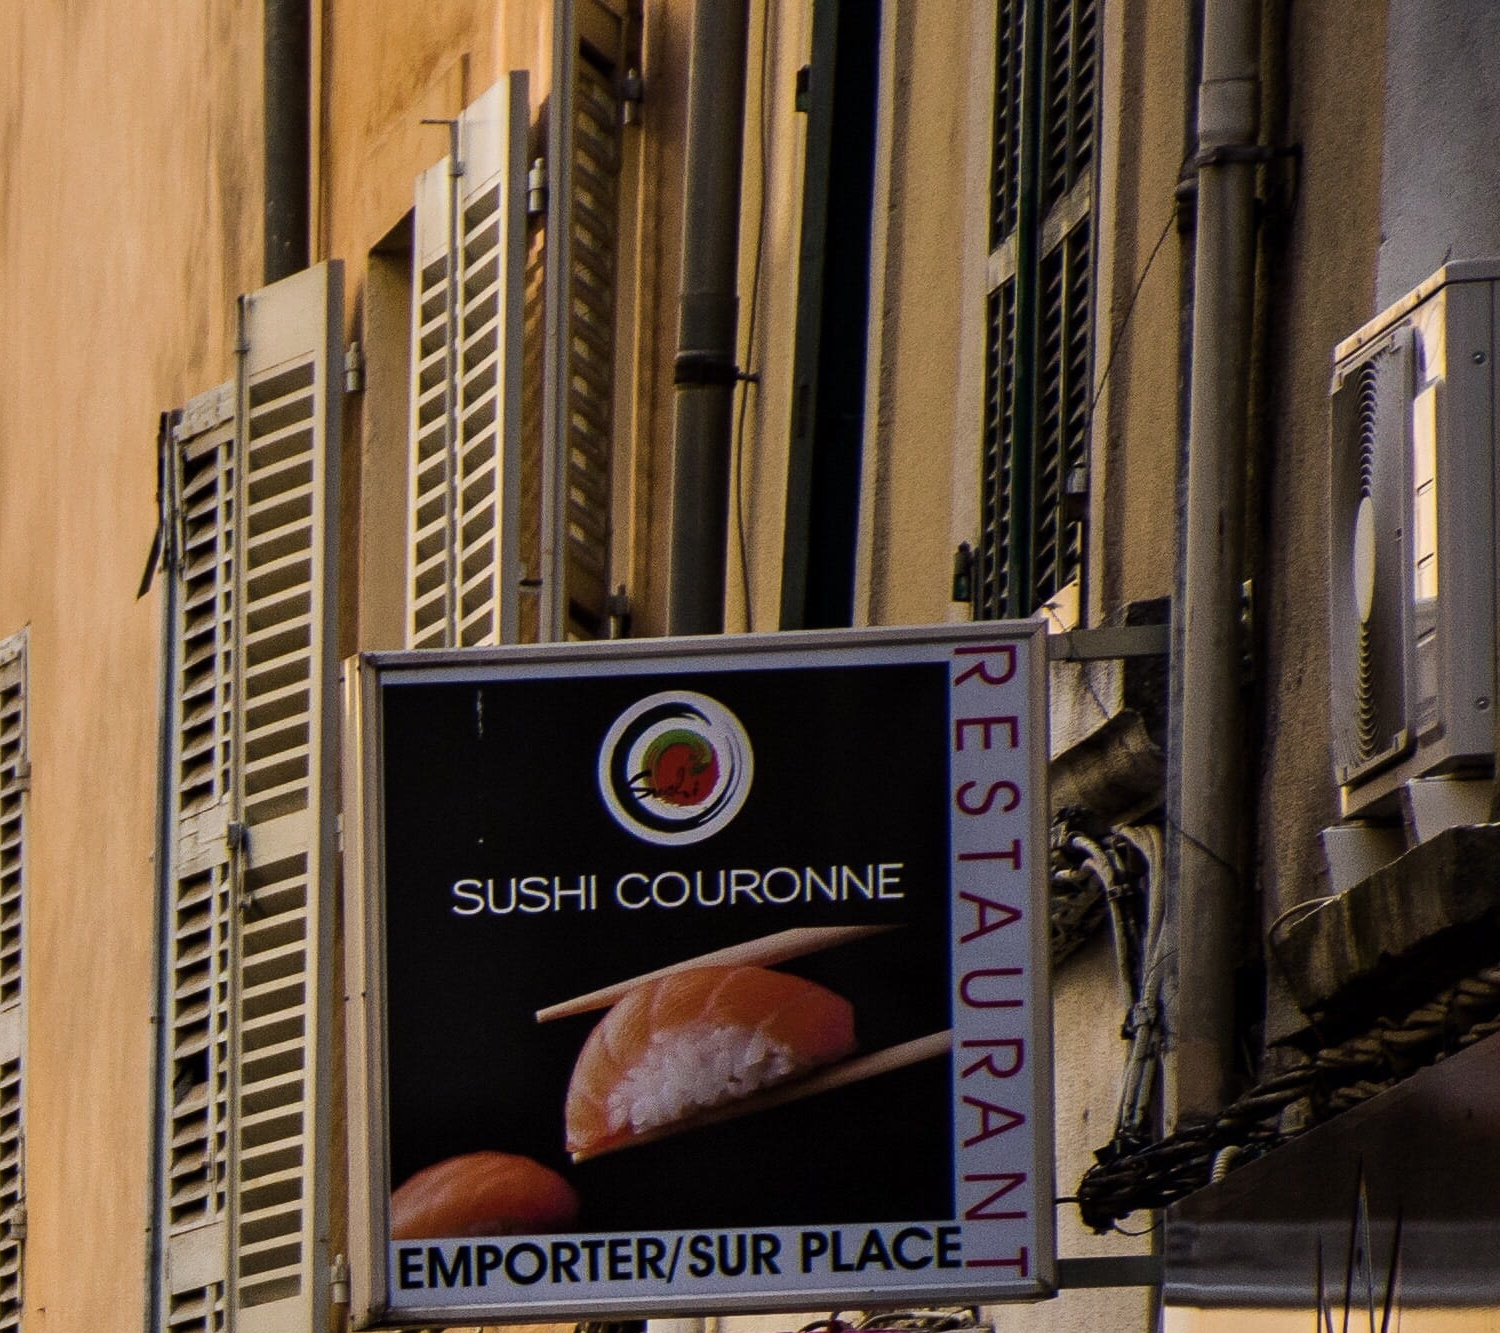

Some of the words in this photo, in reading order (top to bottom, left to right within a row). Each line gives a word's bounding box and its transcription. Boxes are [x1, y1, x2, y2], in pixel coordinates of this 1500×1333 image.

[451, 876, 598, 916] SUSHI
[615, 862, 906, 911] COURONNE
[952, 643, 1029, 1279] RESTAURANT
[802, 1226, 963, 1275] PLACE
